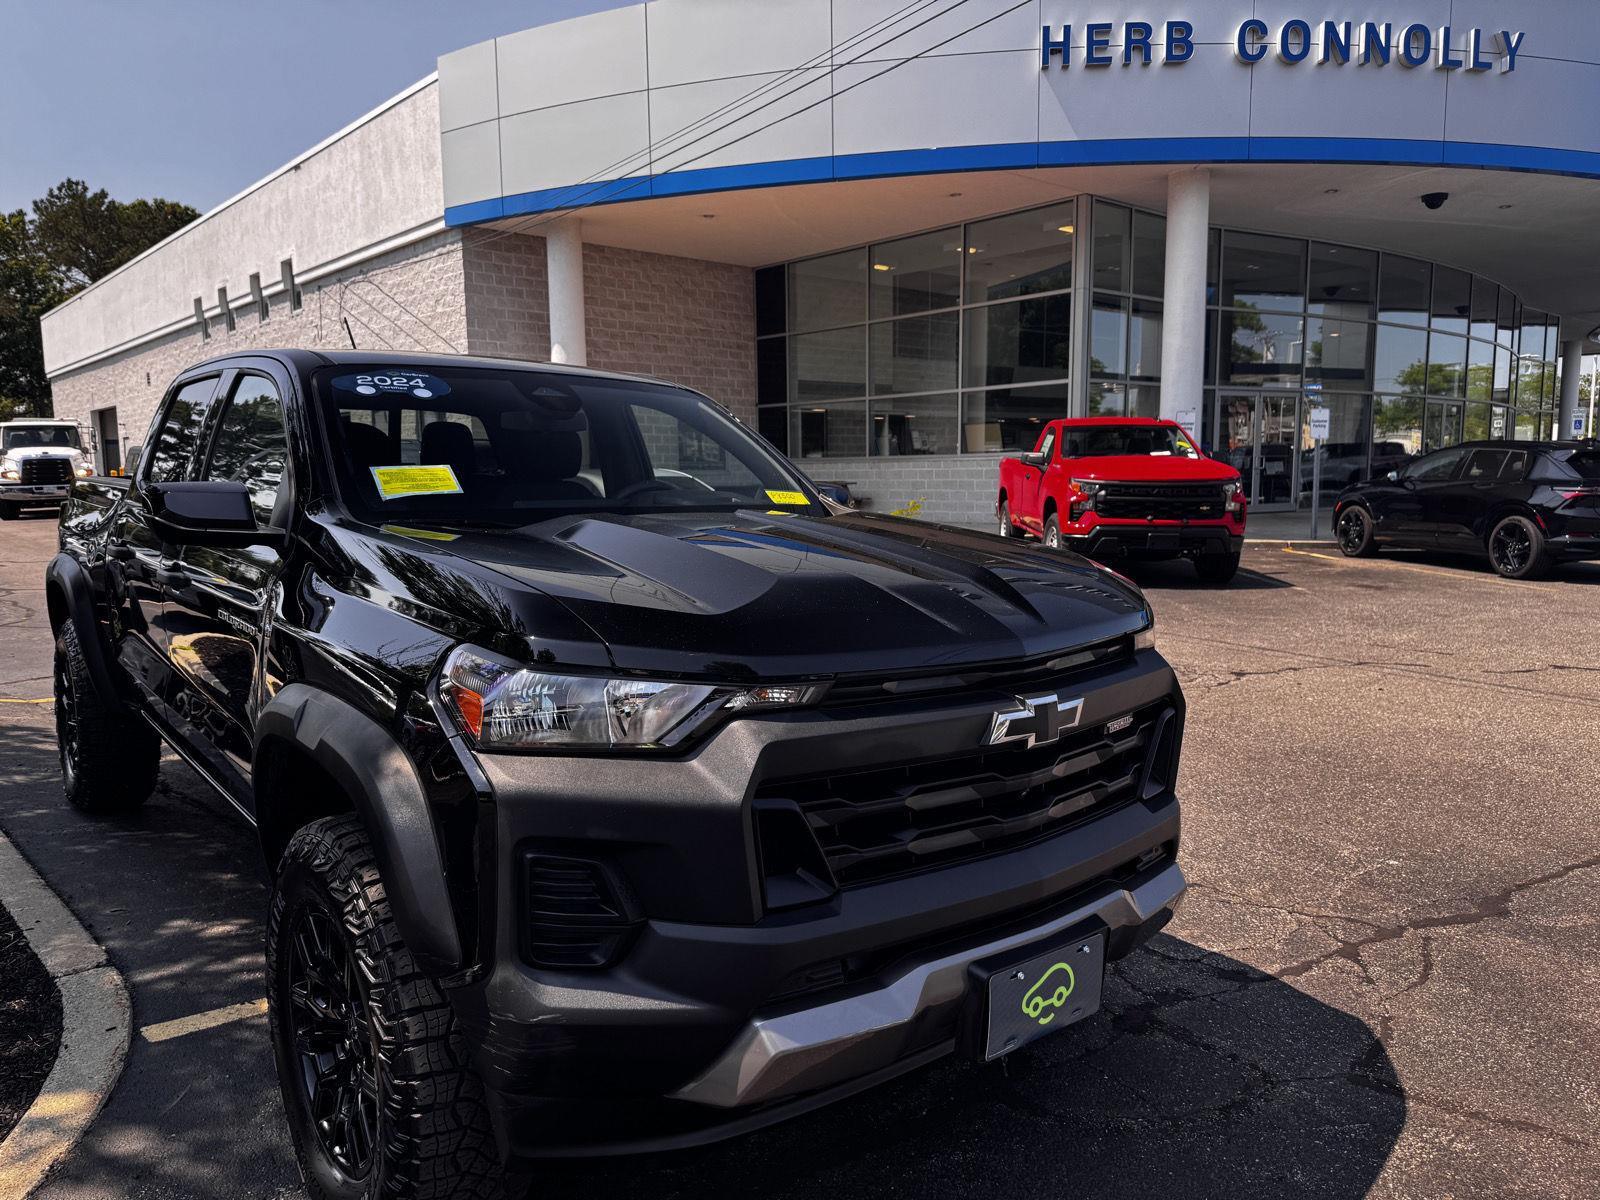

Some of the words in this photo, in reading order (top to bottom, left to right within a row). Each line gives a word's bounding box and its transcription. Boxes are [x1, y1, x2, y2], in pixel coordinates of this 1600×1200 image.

[1041, 21, 1195, 69] HERB
[1234, 19, 1525, 74] CONNOLLY
[356, 375, 426, 388] 2024
